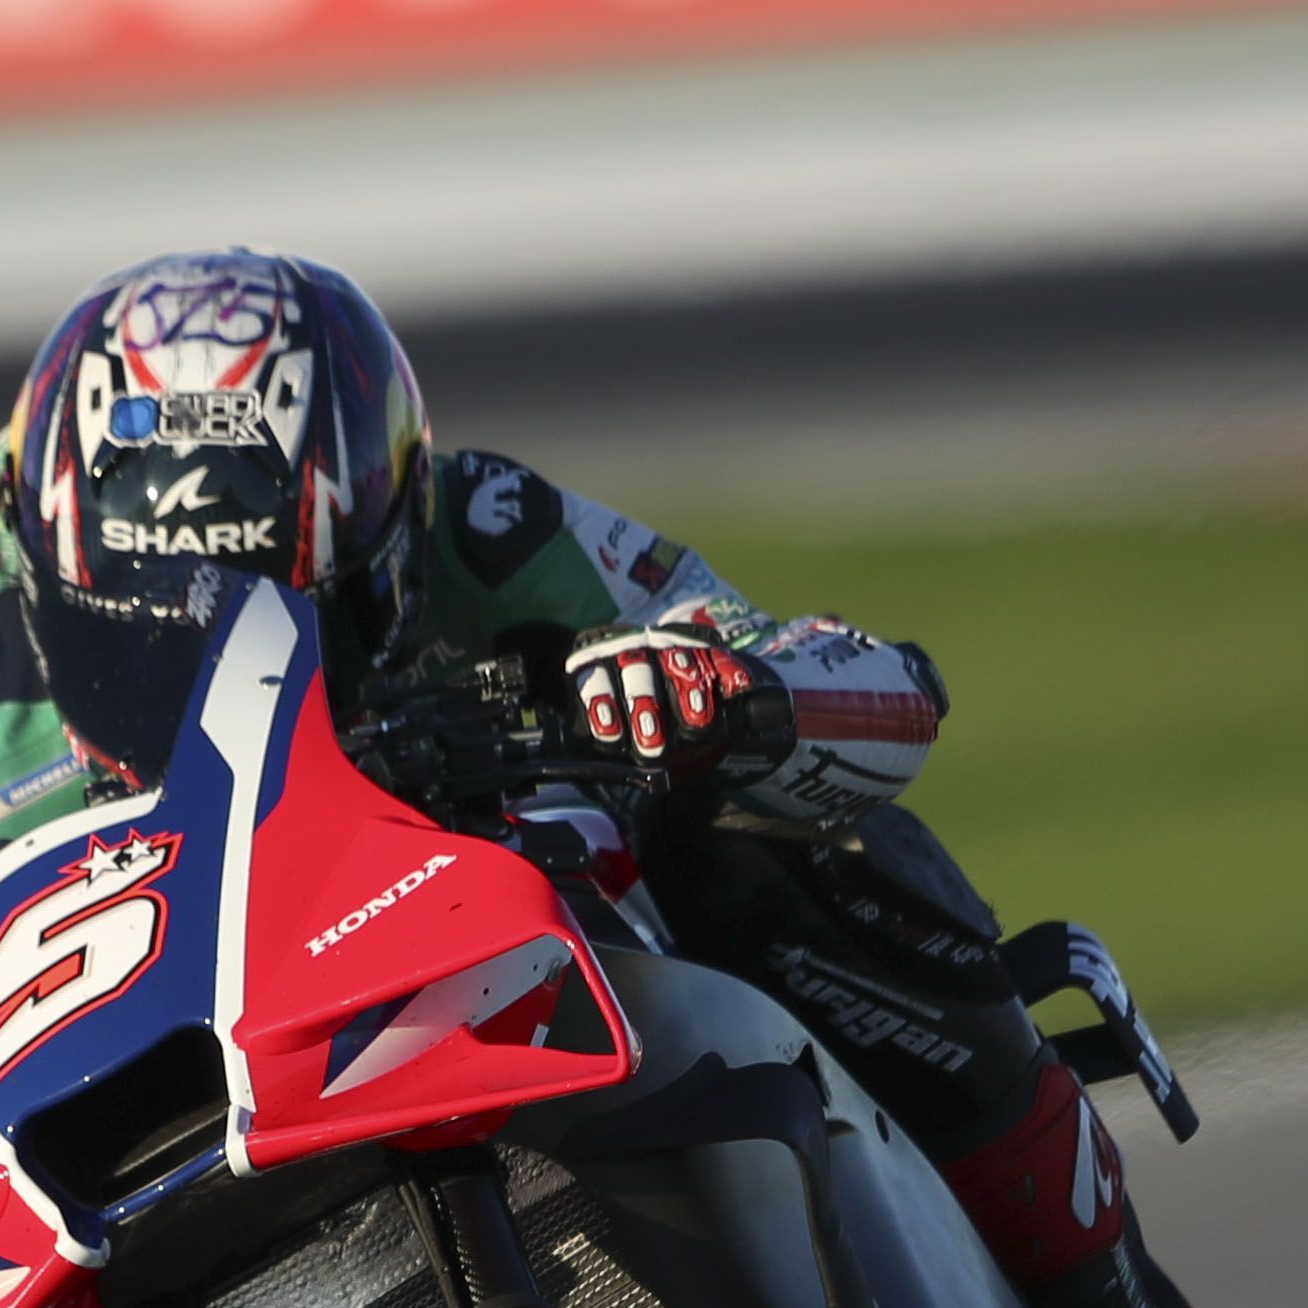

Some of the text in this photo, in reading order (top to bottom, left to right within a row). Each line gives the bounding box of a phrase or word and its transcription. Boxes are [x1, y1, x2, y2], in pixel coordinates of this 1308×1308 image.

[100, 516, 277, 555] SHARK
[8, 757, 81, 804] MICHELI
[303, 854, 458, 958] HONDA
